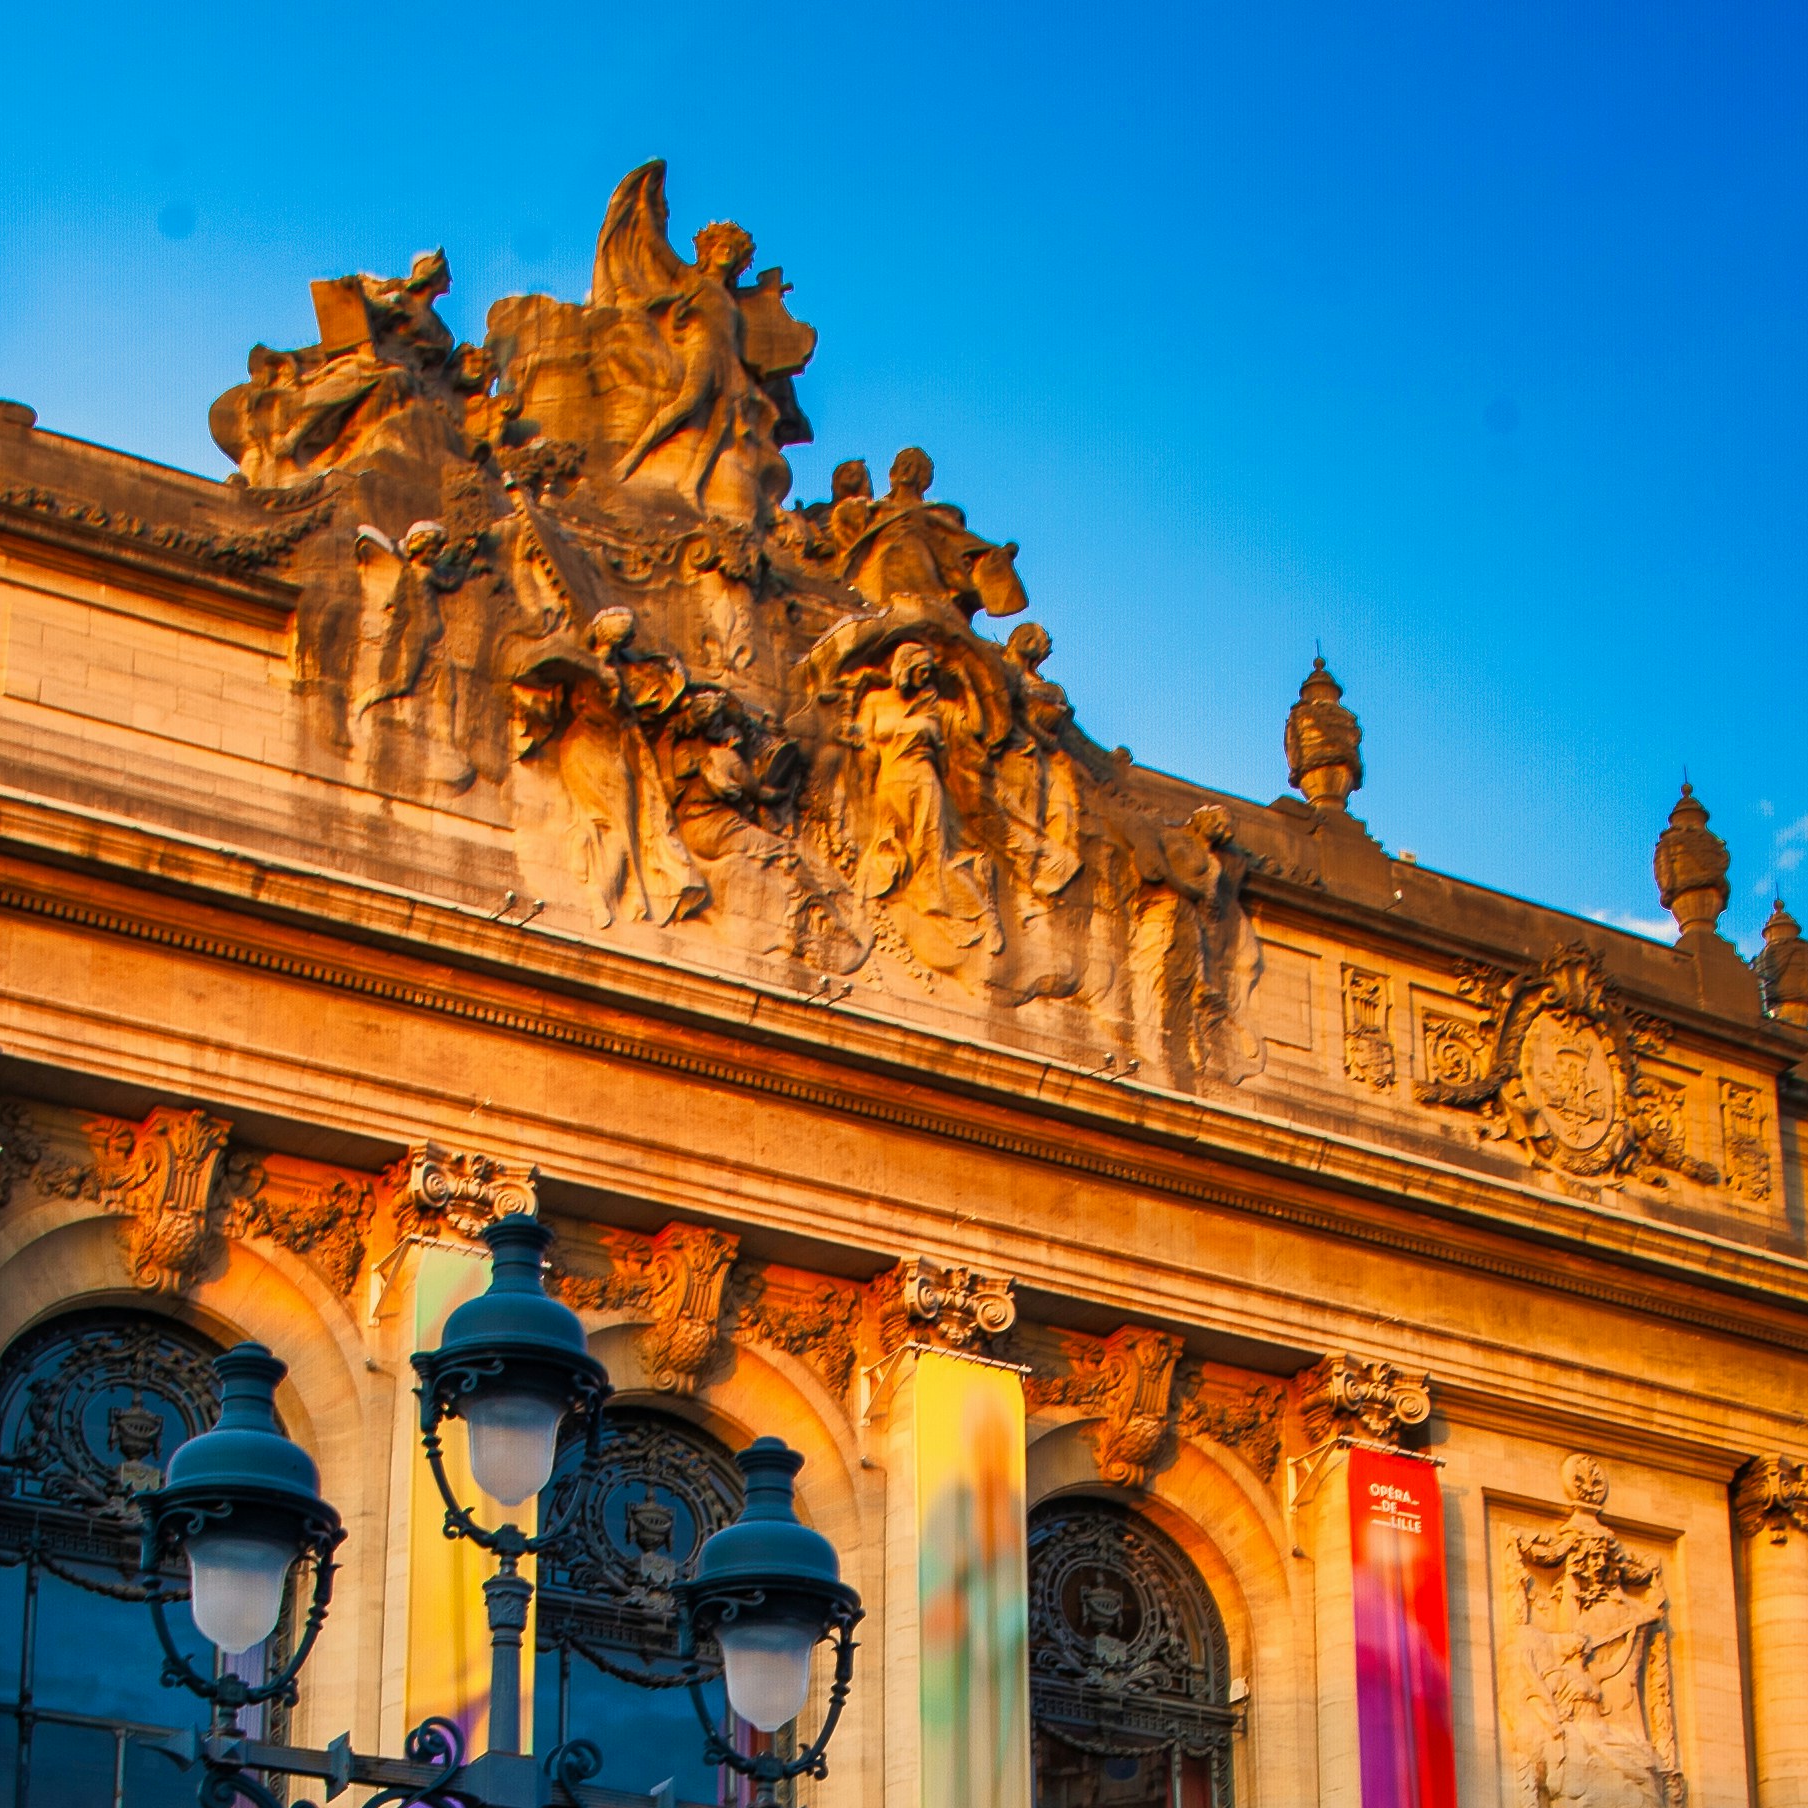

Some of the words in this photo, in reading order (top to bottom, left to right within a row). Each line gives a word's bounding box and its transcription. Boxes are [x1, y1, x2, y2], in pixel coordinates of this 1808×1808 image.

[1369, 1483, 1411, 1503] OPÉRA
[1381, 1500, 1398, 1515] DE
[1390, 1516, 1422, 1533] LILLE
